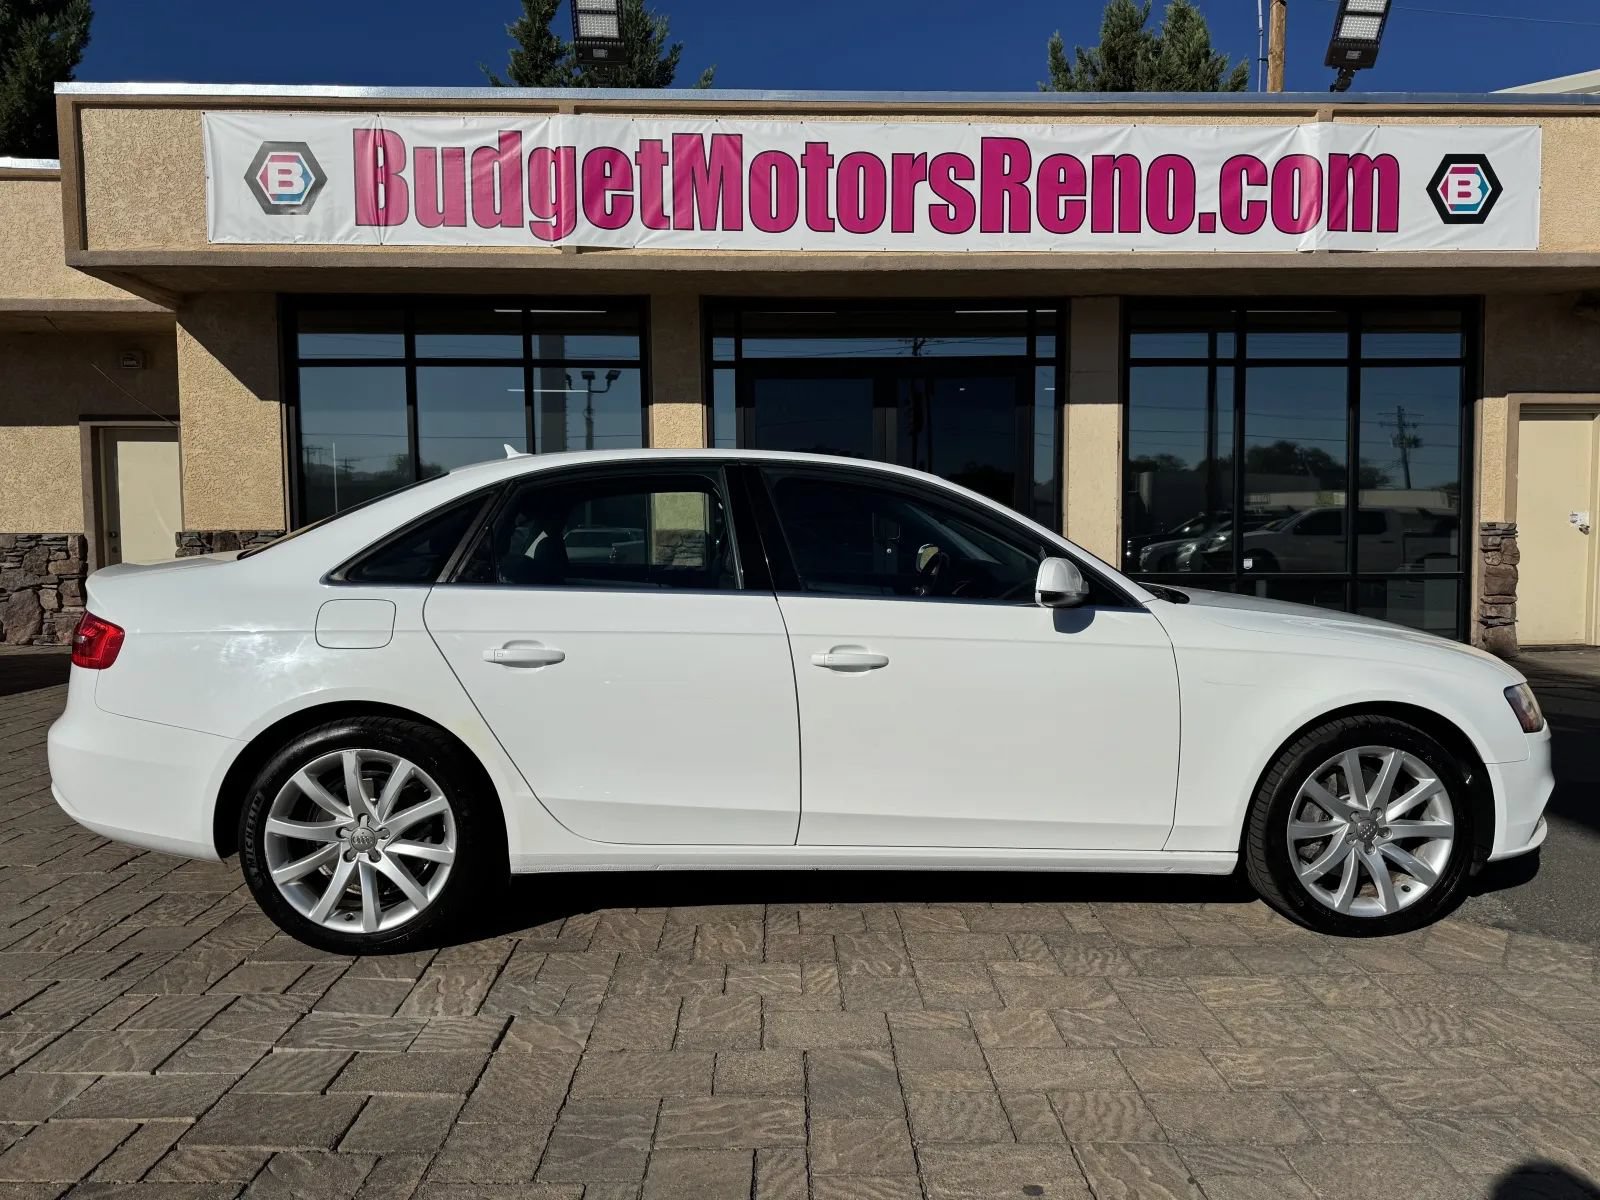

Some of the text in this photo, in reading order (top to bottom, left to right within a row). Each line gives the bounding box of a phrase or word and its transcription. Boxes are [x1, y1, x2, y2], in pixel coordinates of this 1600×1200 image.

[267, 162, 305, 194] B
[353, 128, 1400, 241] BudgetMotorsReno.com
[1447, 173, 1483, 205] B
[244, 793, 263, 868] MICHELIN
